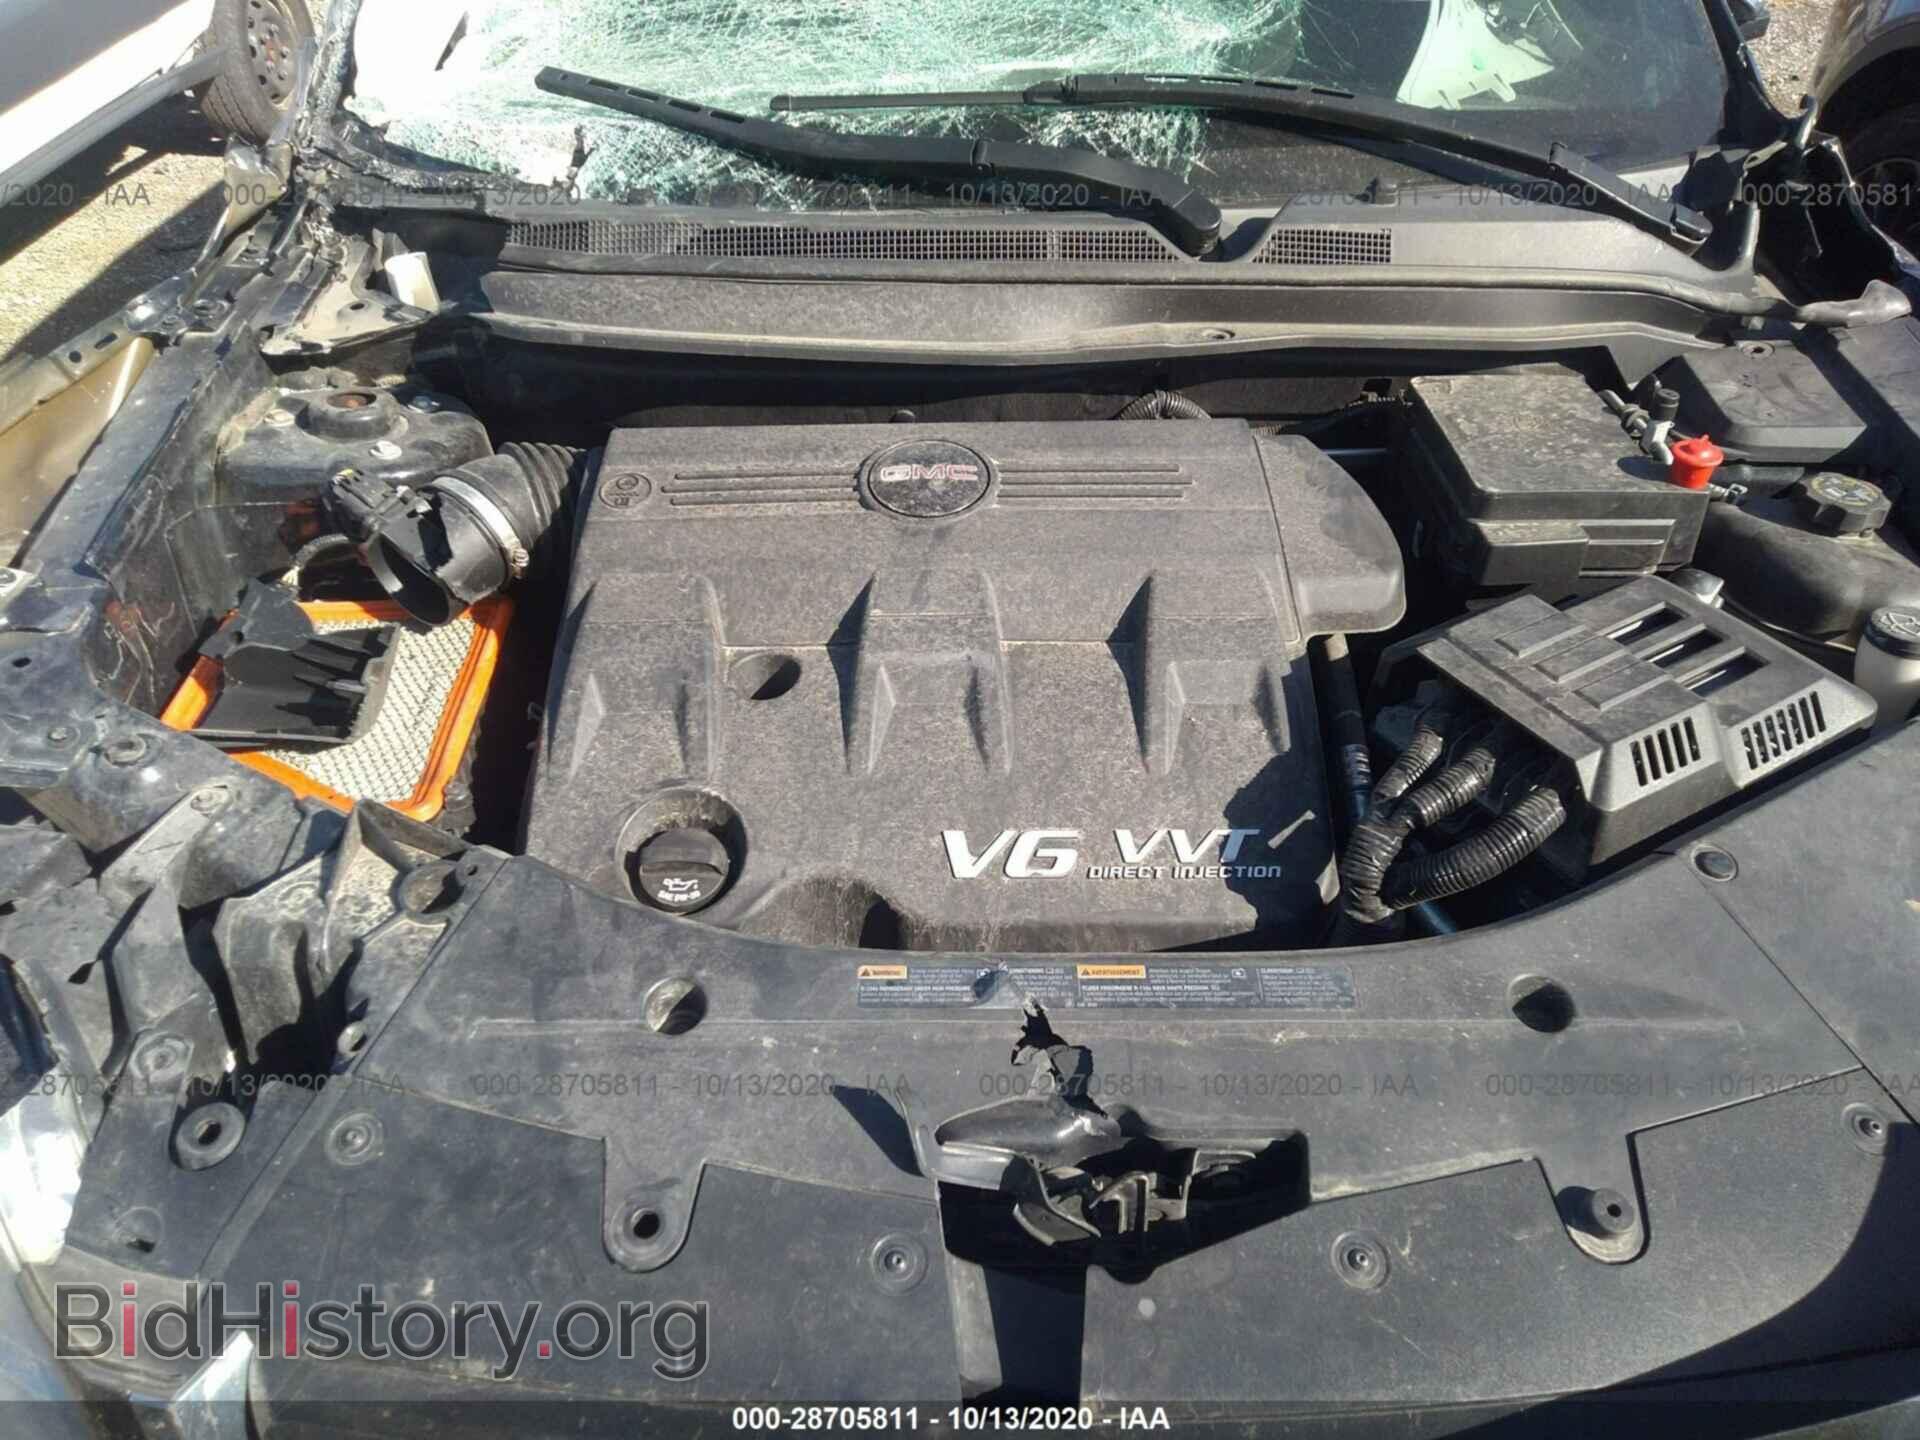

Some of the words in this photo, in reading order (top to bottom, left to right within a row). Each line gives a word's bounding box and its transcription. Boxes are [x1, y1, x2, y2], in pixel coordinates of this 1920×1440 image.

[880, 463, 979, 482] GMC
[941, 829, 1080, 880] V6
[1112, 829, 1261, 864] VVT
[1087, 865, 1163, 880] DIRECT
[1171, 865, 1282, 880] INJECTION
